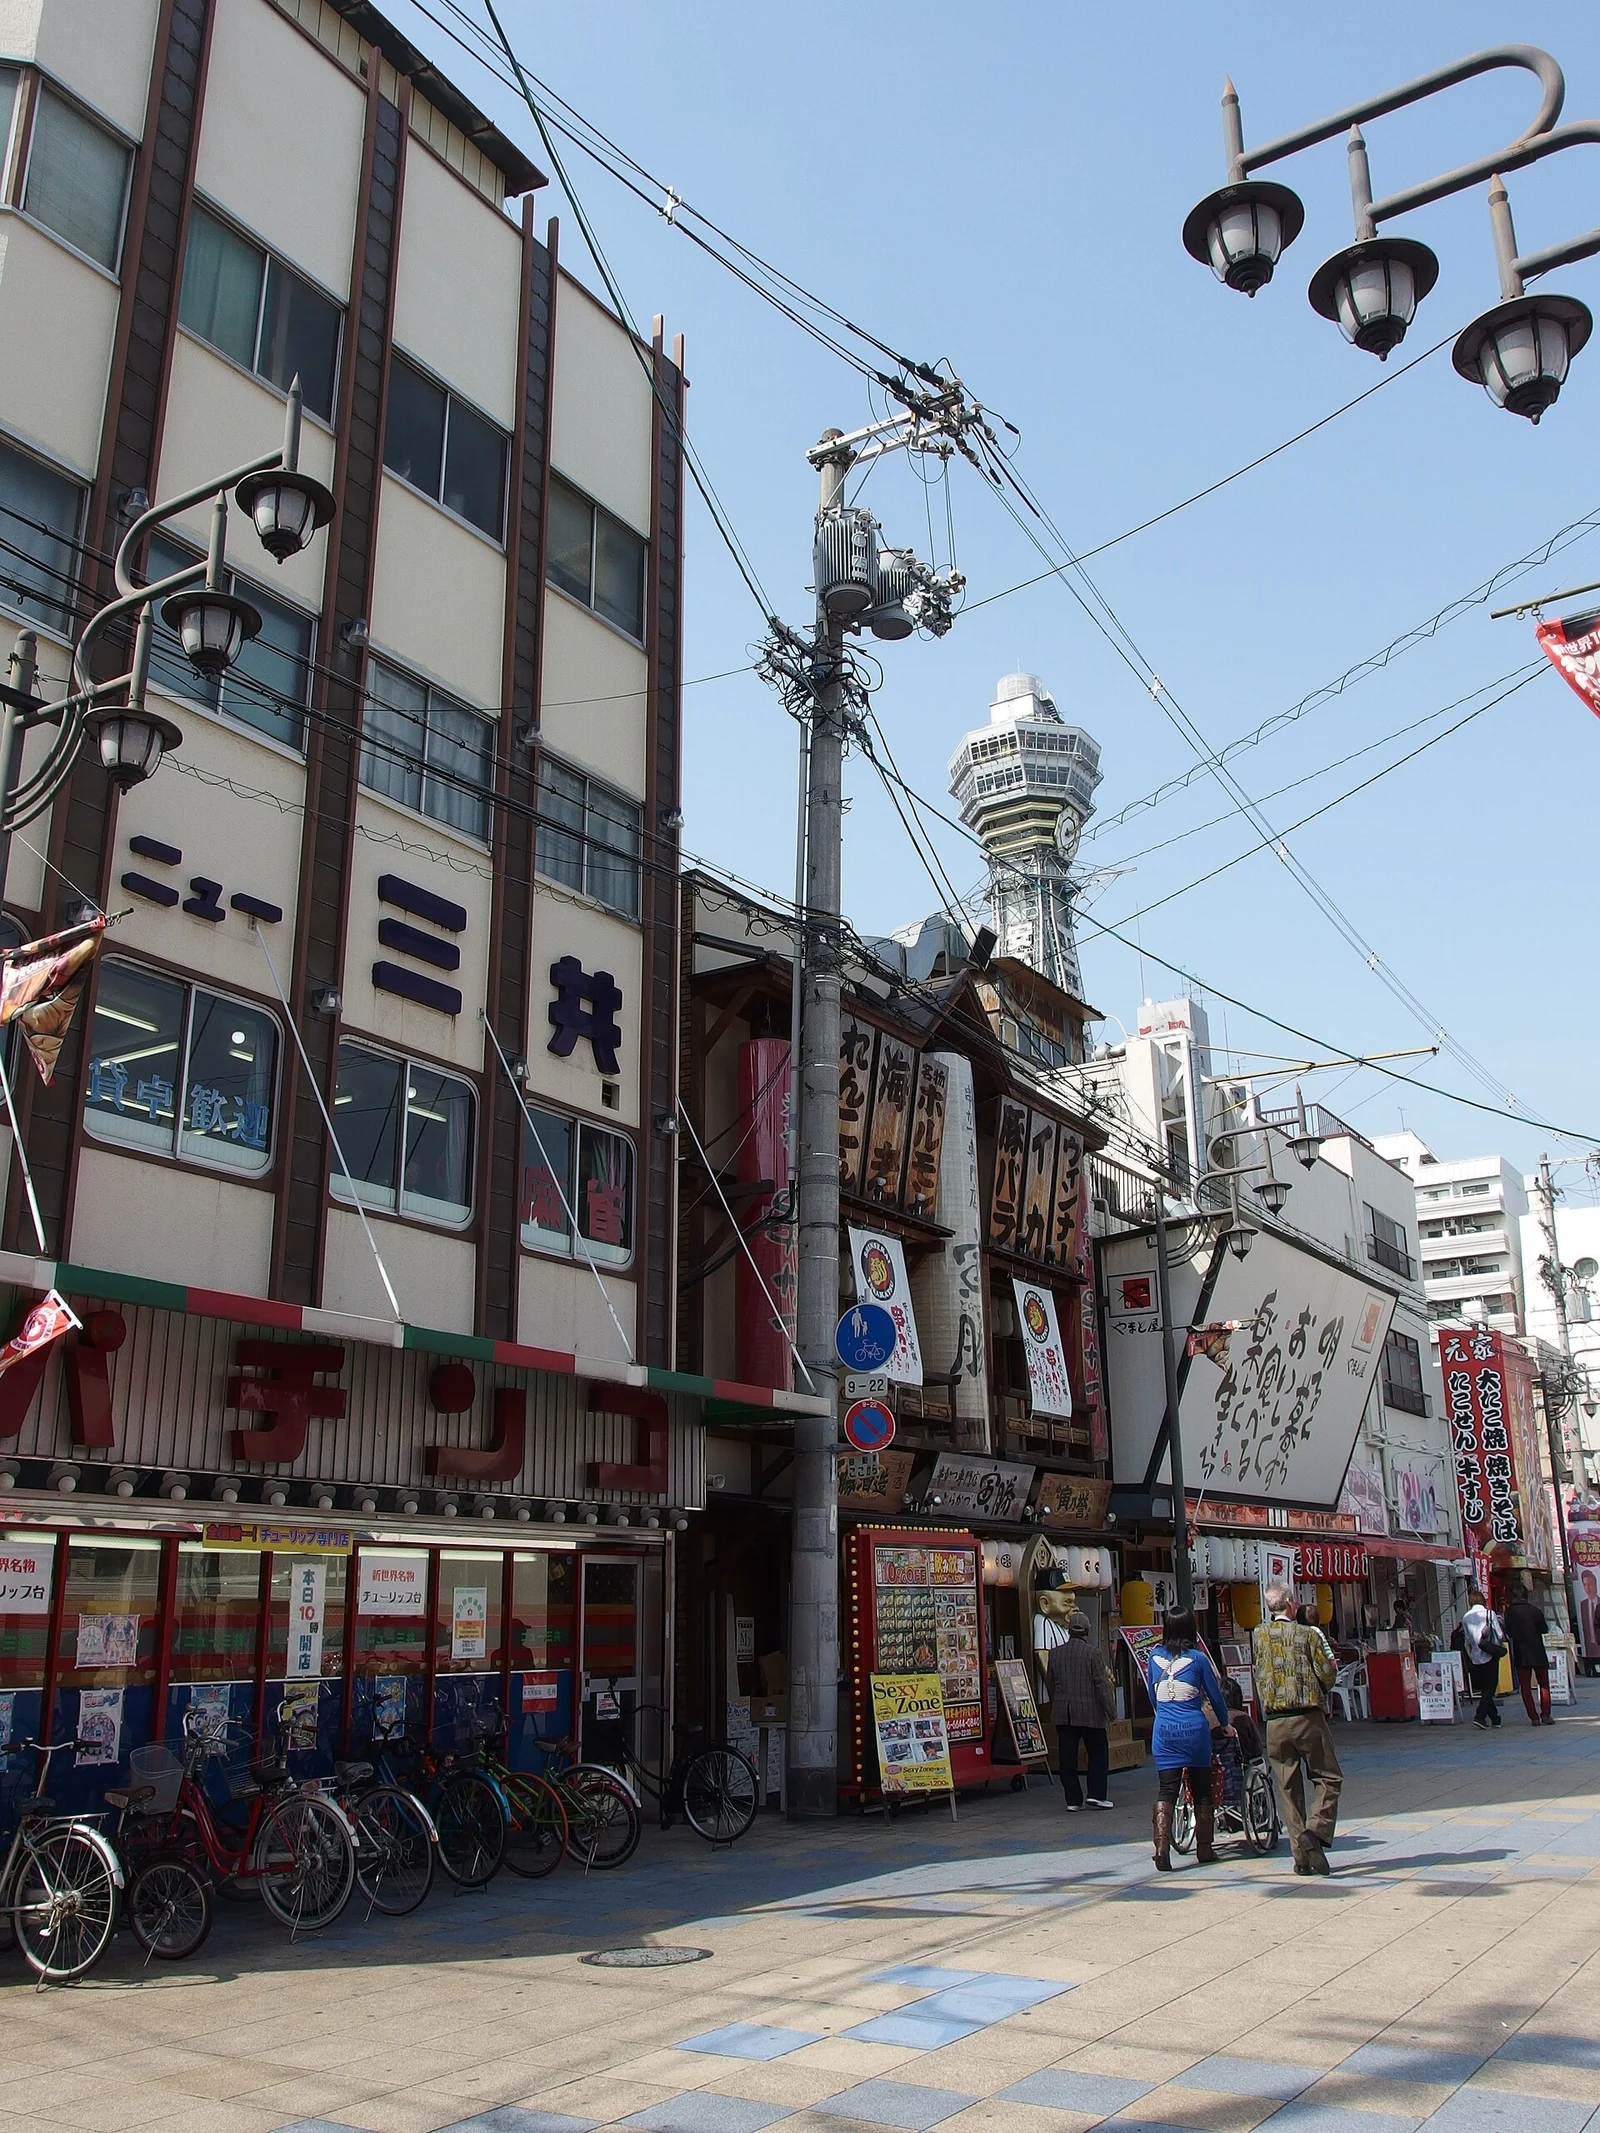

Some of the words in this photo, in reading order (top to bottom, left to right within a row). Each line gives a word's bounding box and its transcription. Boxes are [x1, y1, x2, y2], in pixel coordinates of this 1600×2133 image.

[922, 1063, 945, 1088] 名物
[522, 1165, 626, 1245] 麻雀
[993, 1104, 1025, 1245] 豚バラ
[1026, 1124, 1053, 1259] イカ
[1111, 1318, 1161, 1335] やまと屋
[0, 1299, 668, 1493] パチンコ
[1448, 1371, 1478, 1453] たこせん
[1476, 1368, 1508, 1451] 大たこ焼
[1456, 1453, 1485, 1524] 牛すじ
[1484, 1453, 1519, 1543] 焼きそば
[260, 1526, 349, 1547] チューリップ専門店
[362, 1591, 422, 1604] チューリップ台
[372, 1569, 415, 1583] 新世界名物
[297, 1569, 320, 1671] 本日10時開店
[872, 1681, 919, 1700] Sexy
[895, 1697, 942, 1715] Zone
